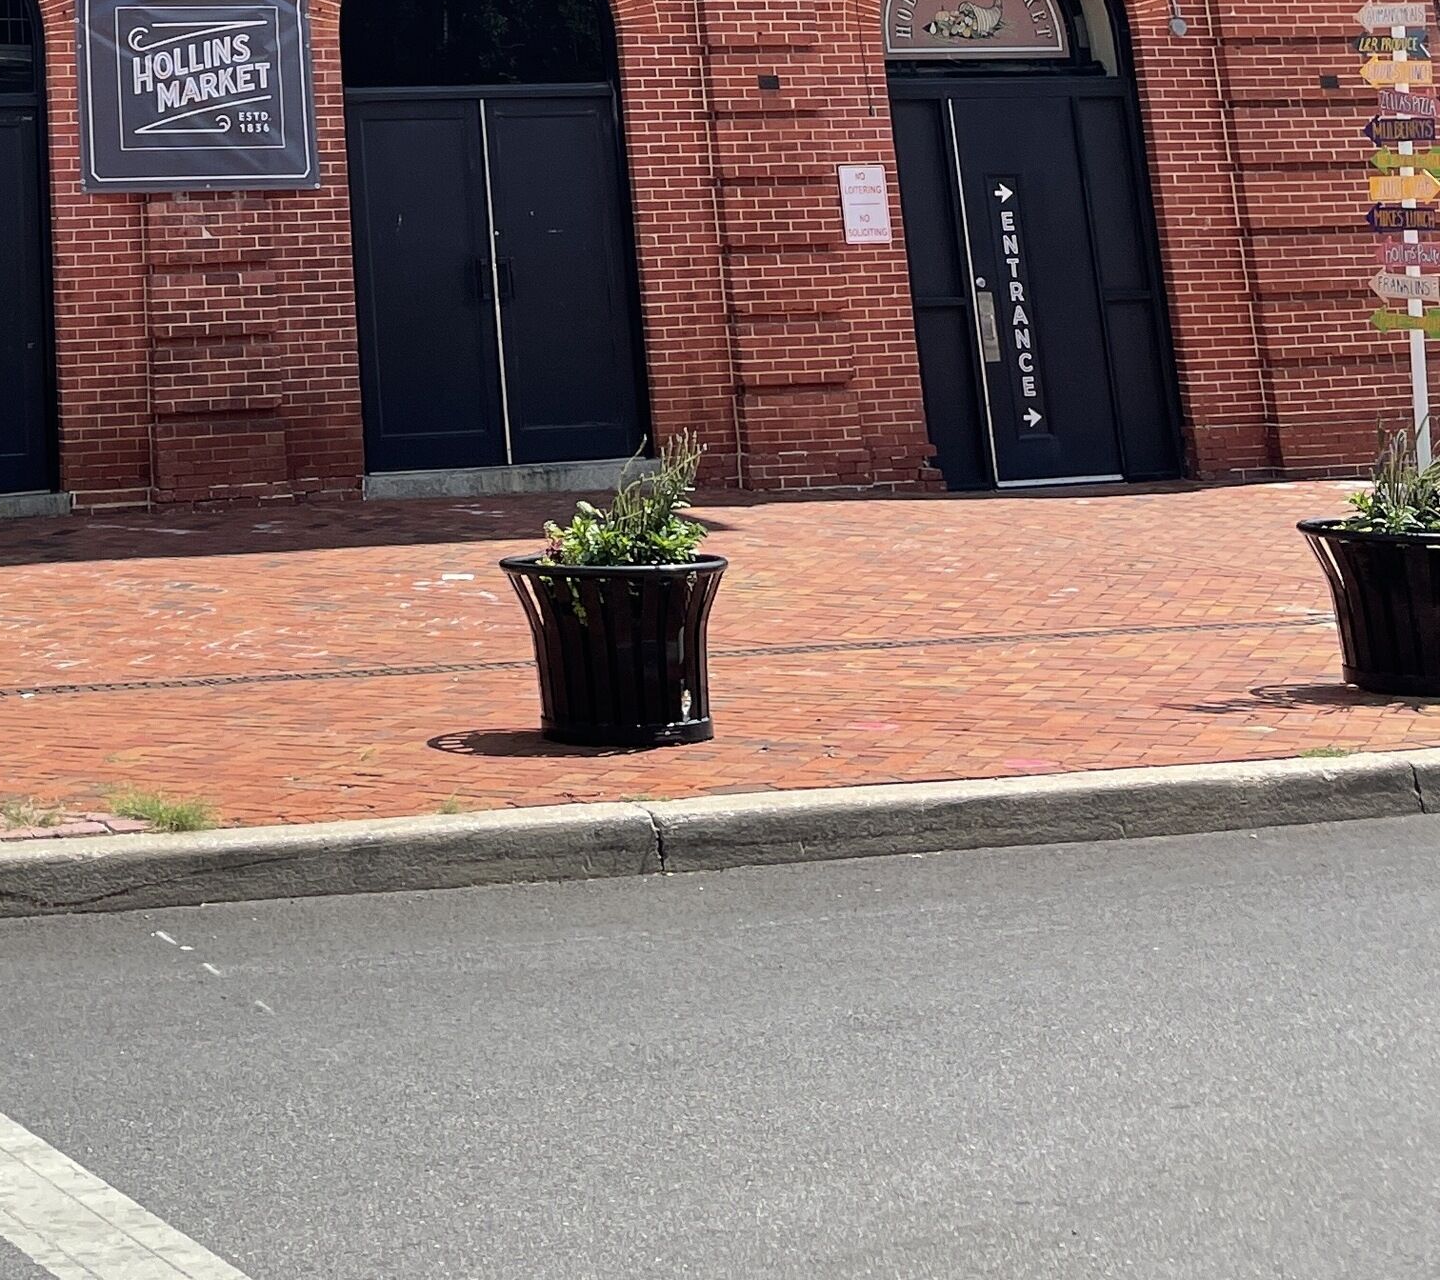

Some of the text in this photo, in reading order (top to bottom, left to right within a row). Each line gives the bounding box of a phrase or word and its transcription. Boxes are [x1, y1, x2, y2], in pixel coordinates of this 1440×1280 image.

[132, 33, 251, 95] HOLLINS
[157, 61, 271, 113] MARKET
[855, 172, 866, 181] NO
[844, 185, 882, 195] LOITERING
[859, 214, 870, 223] NO
[848, 228, 888, 237] SOLICITING
[1000, 211, 1037, 398] ENTRANCE
